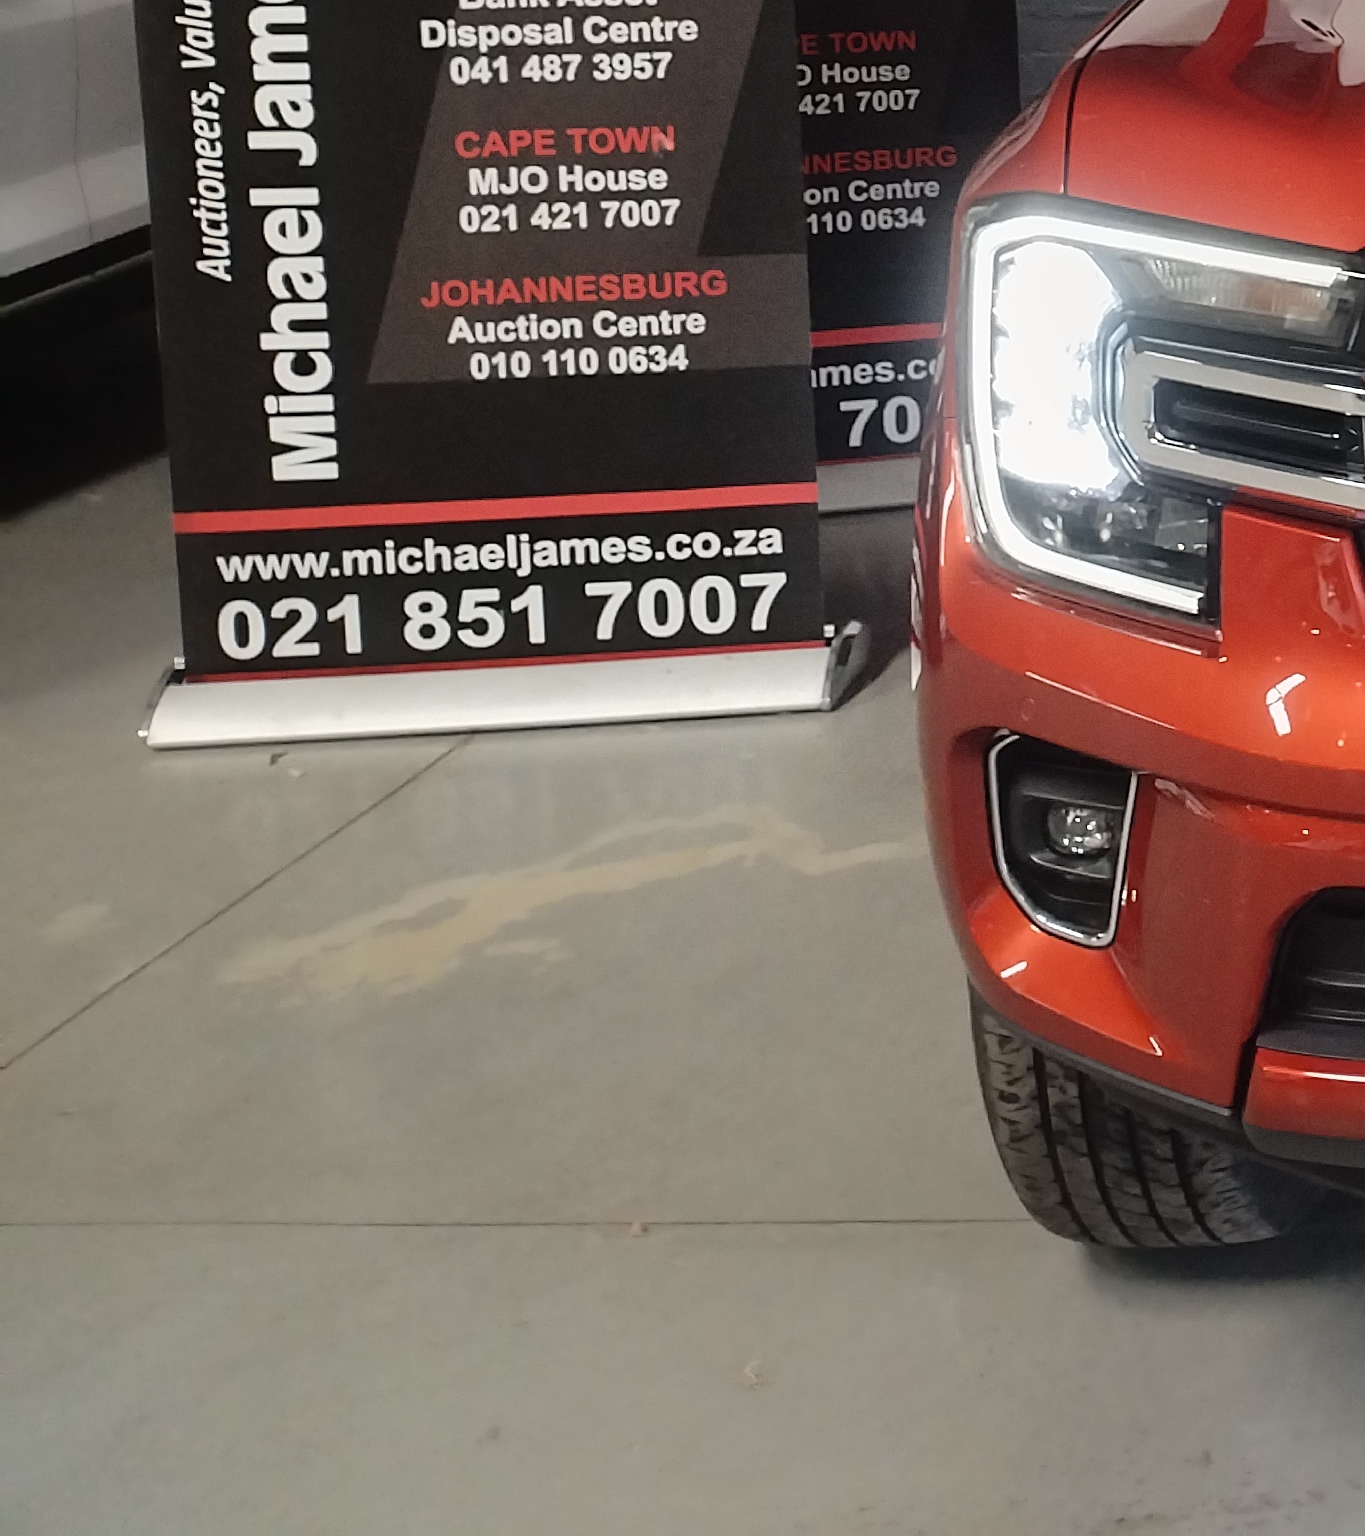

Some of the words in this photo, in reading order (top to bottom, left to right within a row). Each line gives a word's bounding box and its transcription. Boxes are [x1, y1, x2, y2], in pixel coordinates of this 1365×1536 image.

[420, 16, 574, 54] Disposal
[582, 15, 699, 44] Centre
[829, 30, 917, 53] TOWN
[449, 55, 509, 85] 041
[520, 53, 583, 82] 487
[592, 51, 673, 81] 3957
[821, 62, 911, 85] House
[855, 88, 921, 112] 7007
[454, 129, 557, 159] CAPE
[565, 125, 675, 155] TOWN
[189, 81, 232, 282] Auctioneers,
[468, 165, 549, 196] MJO
[558, 164, 669, 193] House
[848, 178, 941, 202] Centre
[459, 203, 518, 234] 021
[530, 201, 588, 230] 421
[600, 198, 681, 228] 7007
[806, 209, 853, 234] 110
[860, 205, 927, 231] 0634
[420, 269, 728, 308] JOHANNESBURG
[247, 186, 338, 482] Michael
[447, 313, 584, 344] Auction
[592, 309, 707, 338] Centre
[469, 350, 531, 380] 010
[541, 347, 599, 377] 110
[608, 343, 689, 375] 0634
[216, 527, 785, 579] www.michaeljames.co.za
[217, 593, 362, 660] 021
[403, 584, 546, 651] 851
[584, 571, 787, 640] 7007
